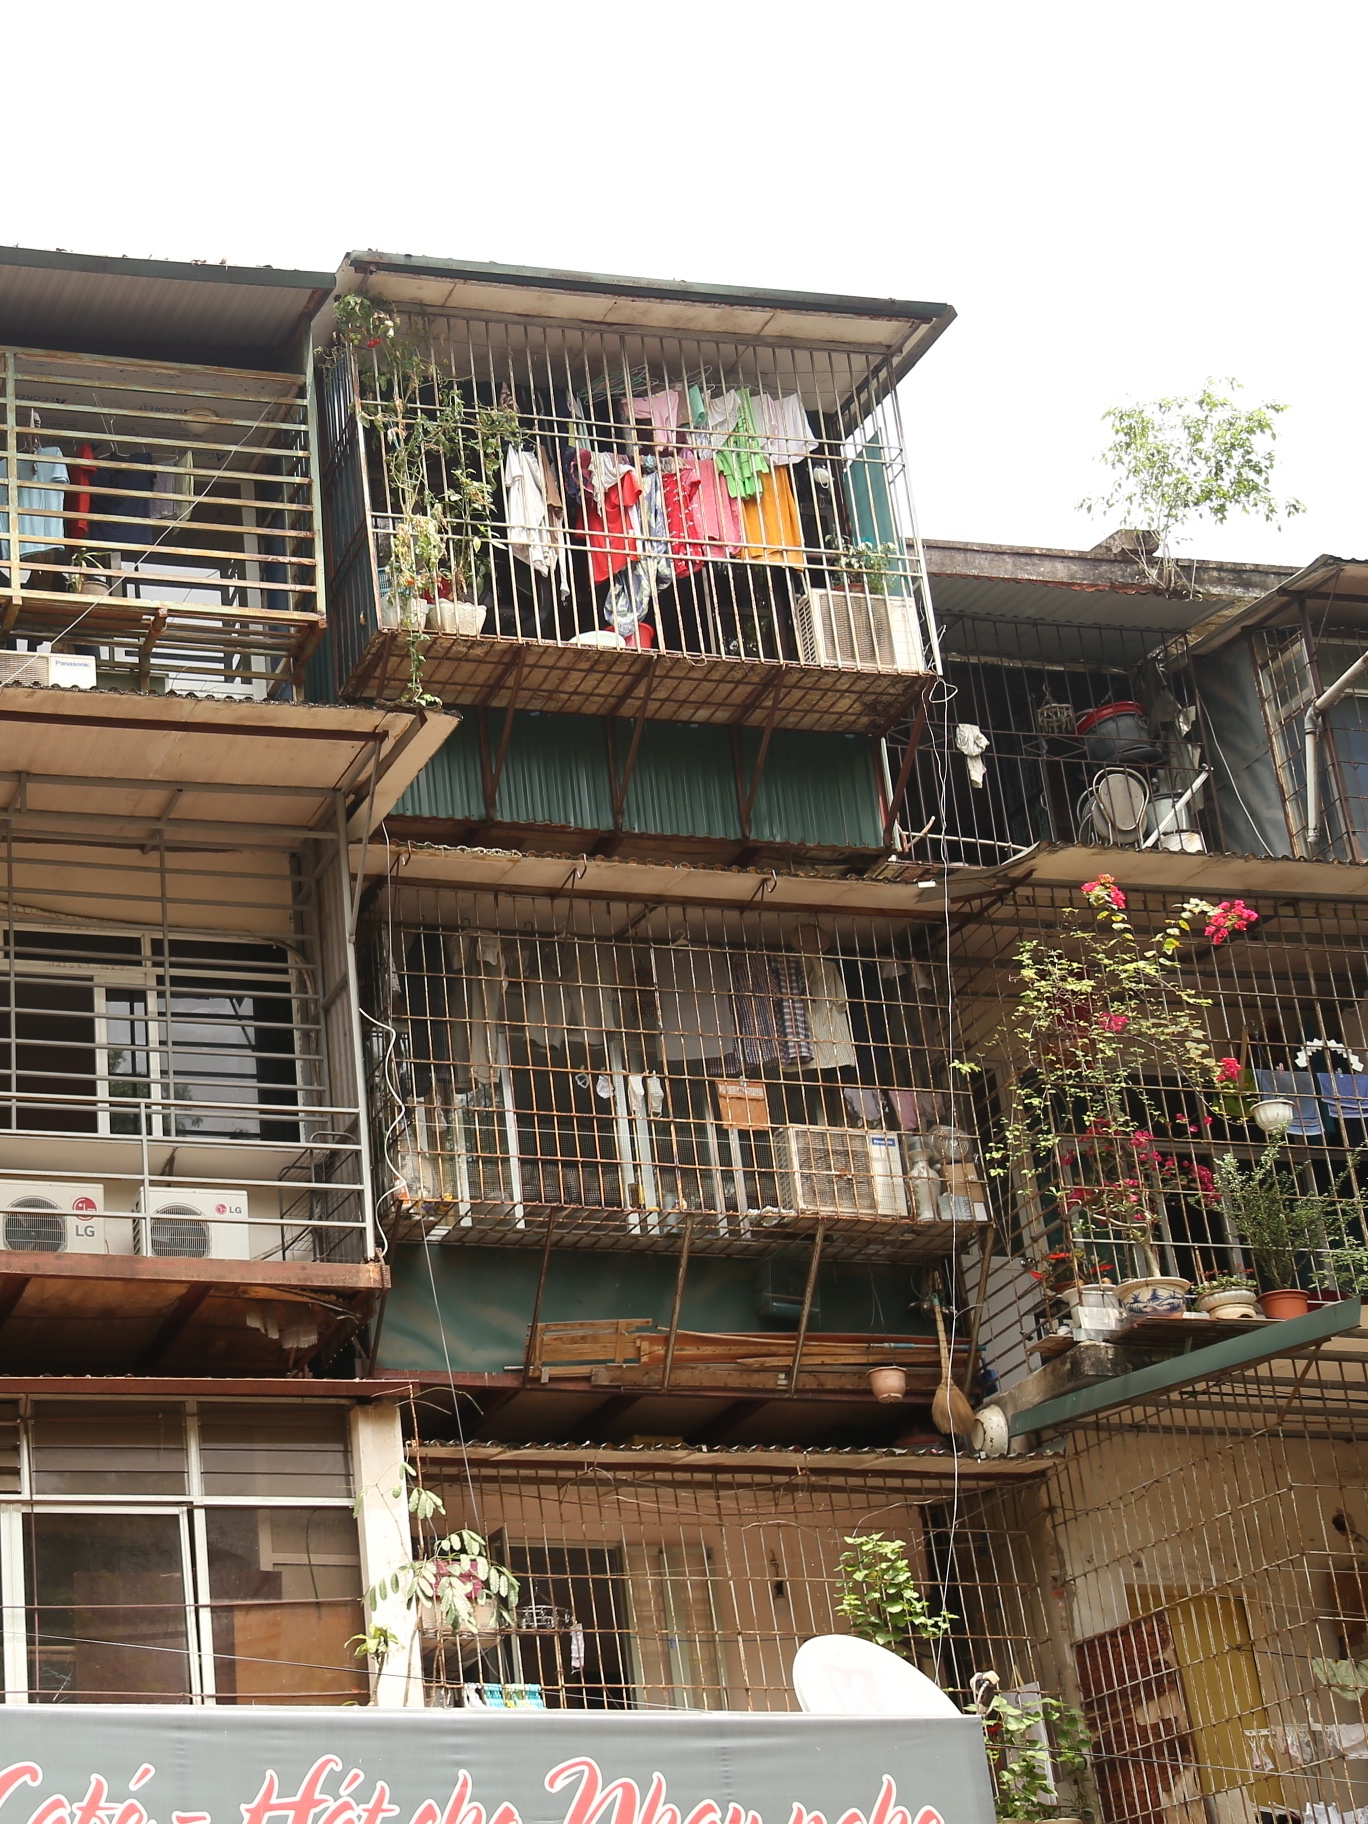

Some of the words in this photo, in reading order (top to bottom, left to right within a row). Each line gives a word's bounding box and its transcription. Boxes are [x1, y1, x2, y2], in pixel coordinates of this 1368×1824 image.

[55, 660, 91, 668] Panasonic
[229, 1206, 242, 1214] LG
[75, 1224, 95, 1237] LG
